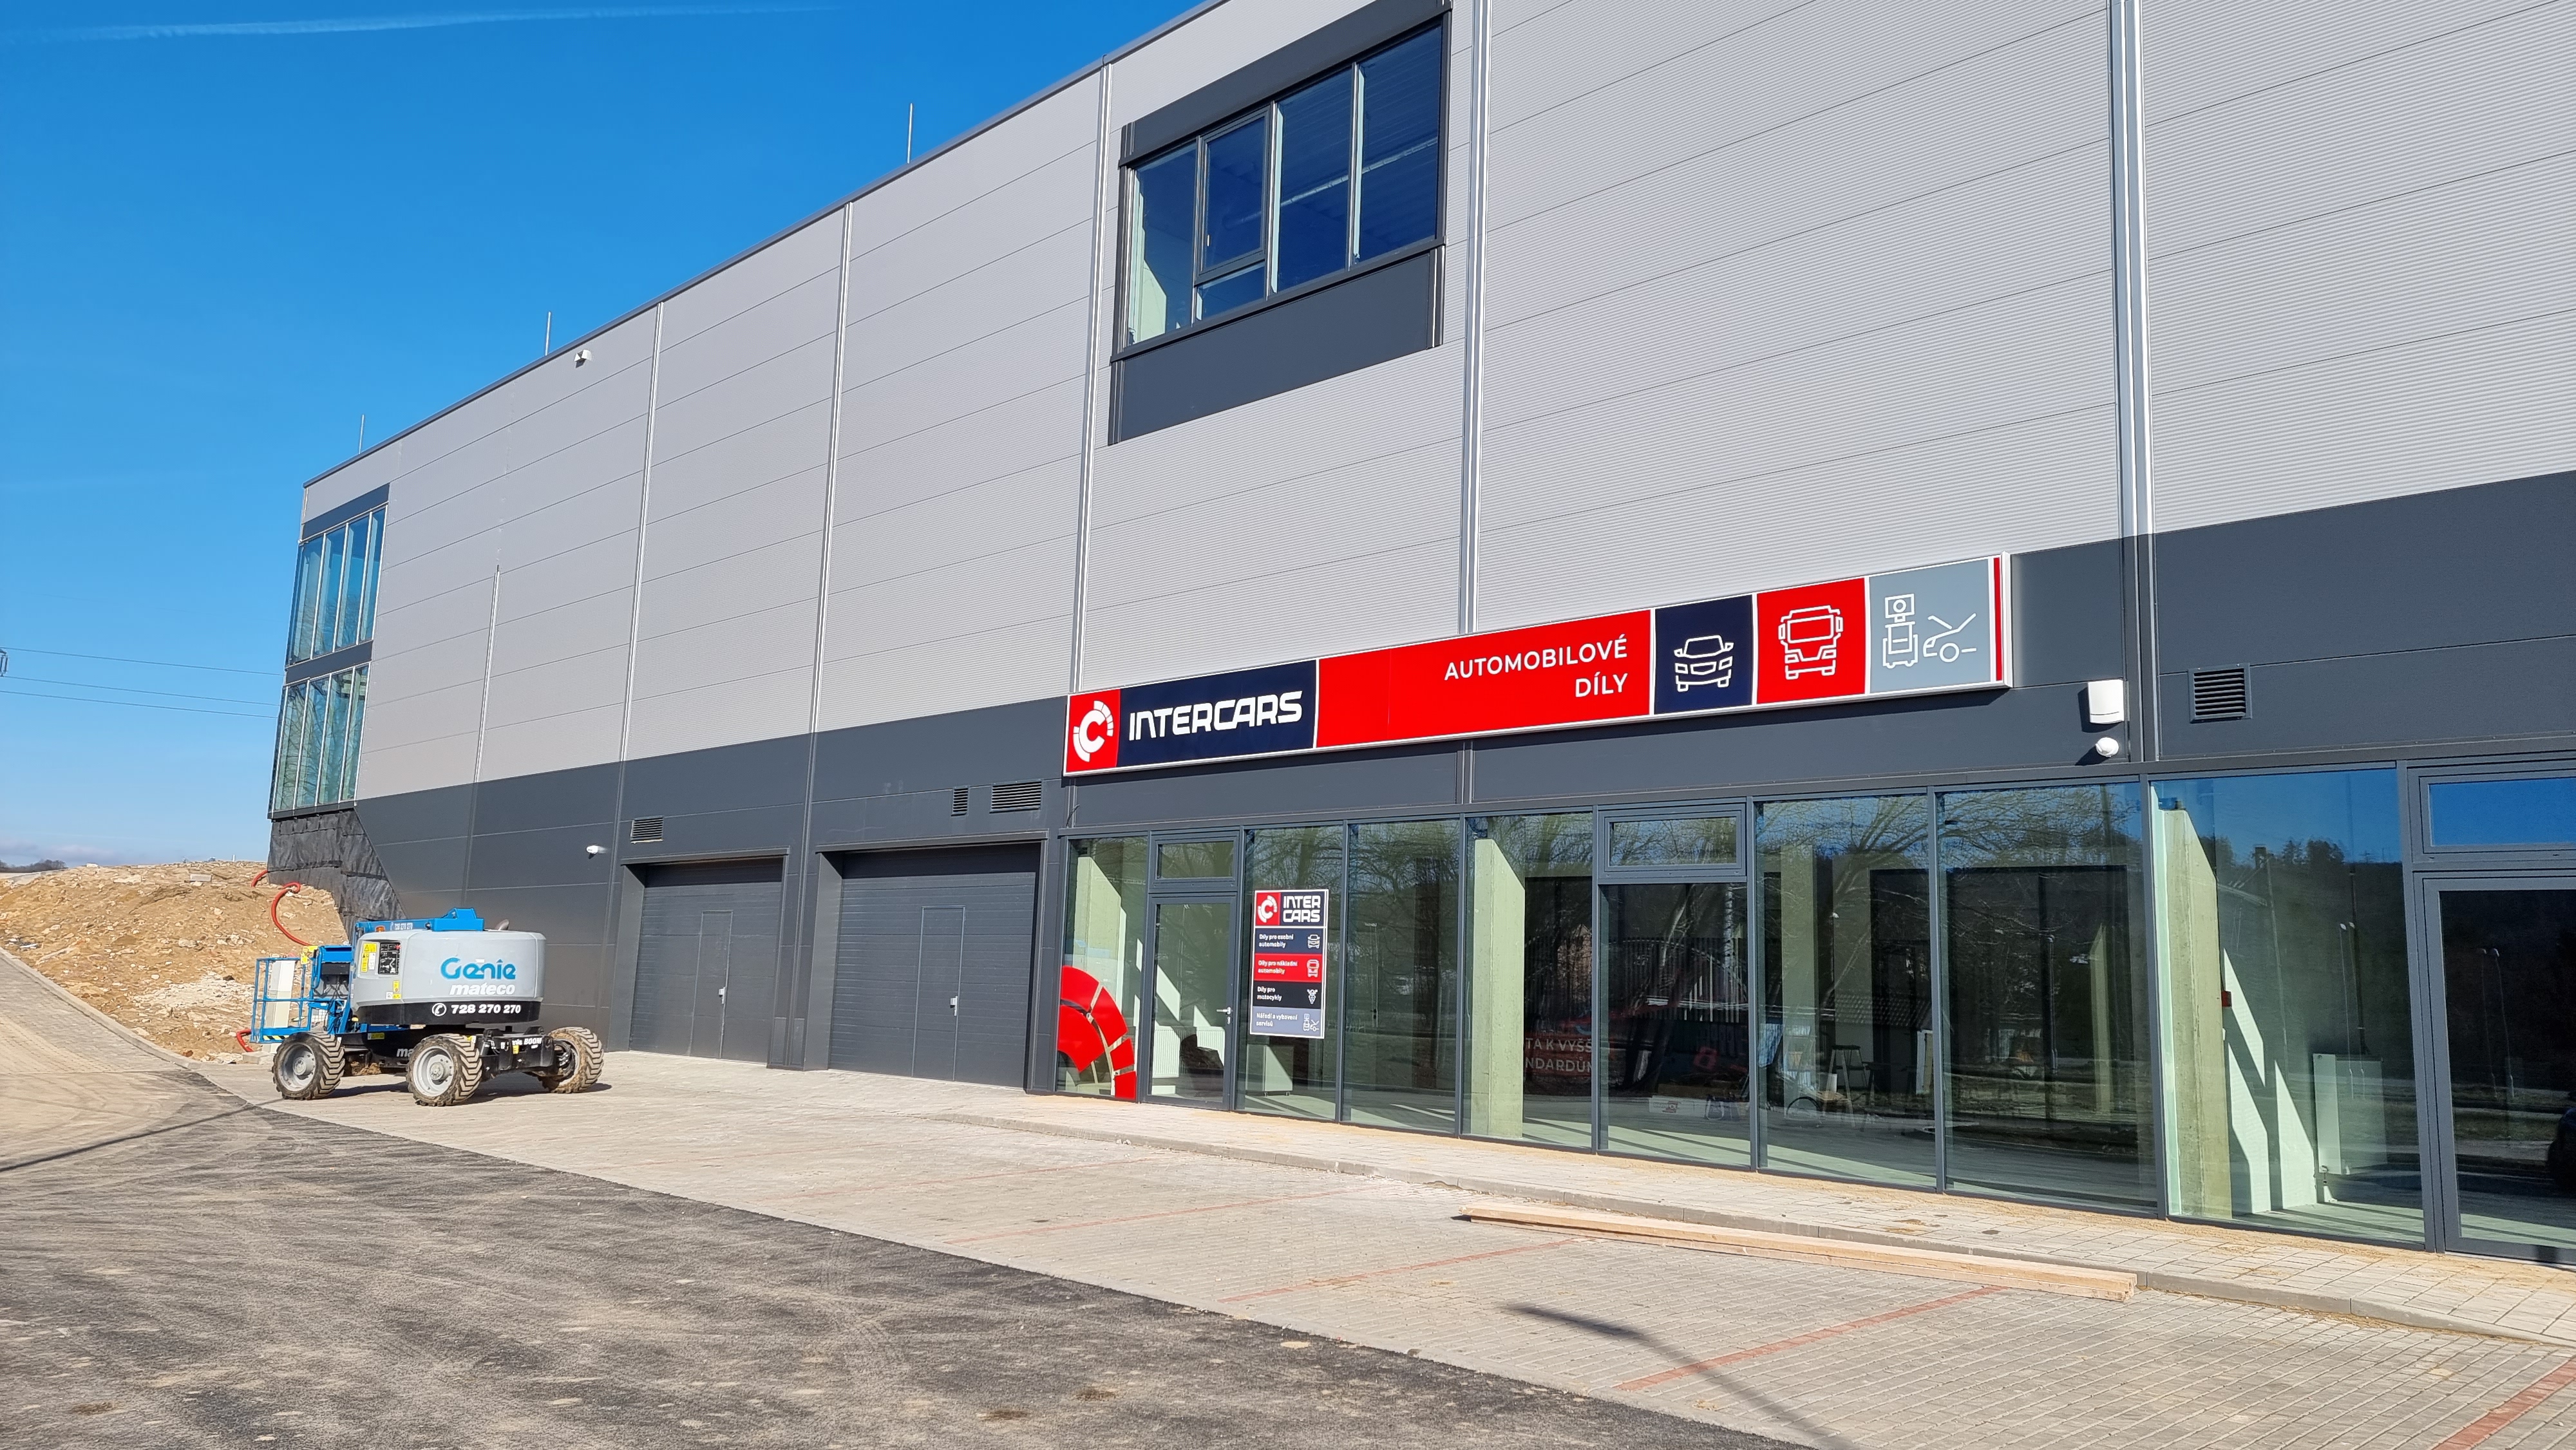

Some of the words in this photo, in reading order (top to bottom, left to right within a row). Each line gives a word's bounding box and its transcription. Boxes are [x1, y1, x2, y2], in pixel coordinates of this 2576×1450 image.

[1444, 633, 1629, 681] AUTOMOBILOVÉ
[1575, 672, 1629, 699] DÍLY
[1129, 690, 1303, 742] INTERCARS
[1283, 895, 1321, 909] INTER
[1282, 909, 1321, 923] CARS
[440, 957, 516, 980] Genie
[449, 983, 515, 995] mateco
[451, 1004, 476, 1014] 728
[478, 1004, 501, 1014] 270
[503, 1004, 522, 1014] 270
[1546, 1039, 1554, 1050] K
[1558, 1038, 1592, 1053] VYŠŠ
